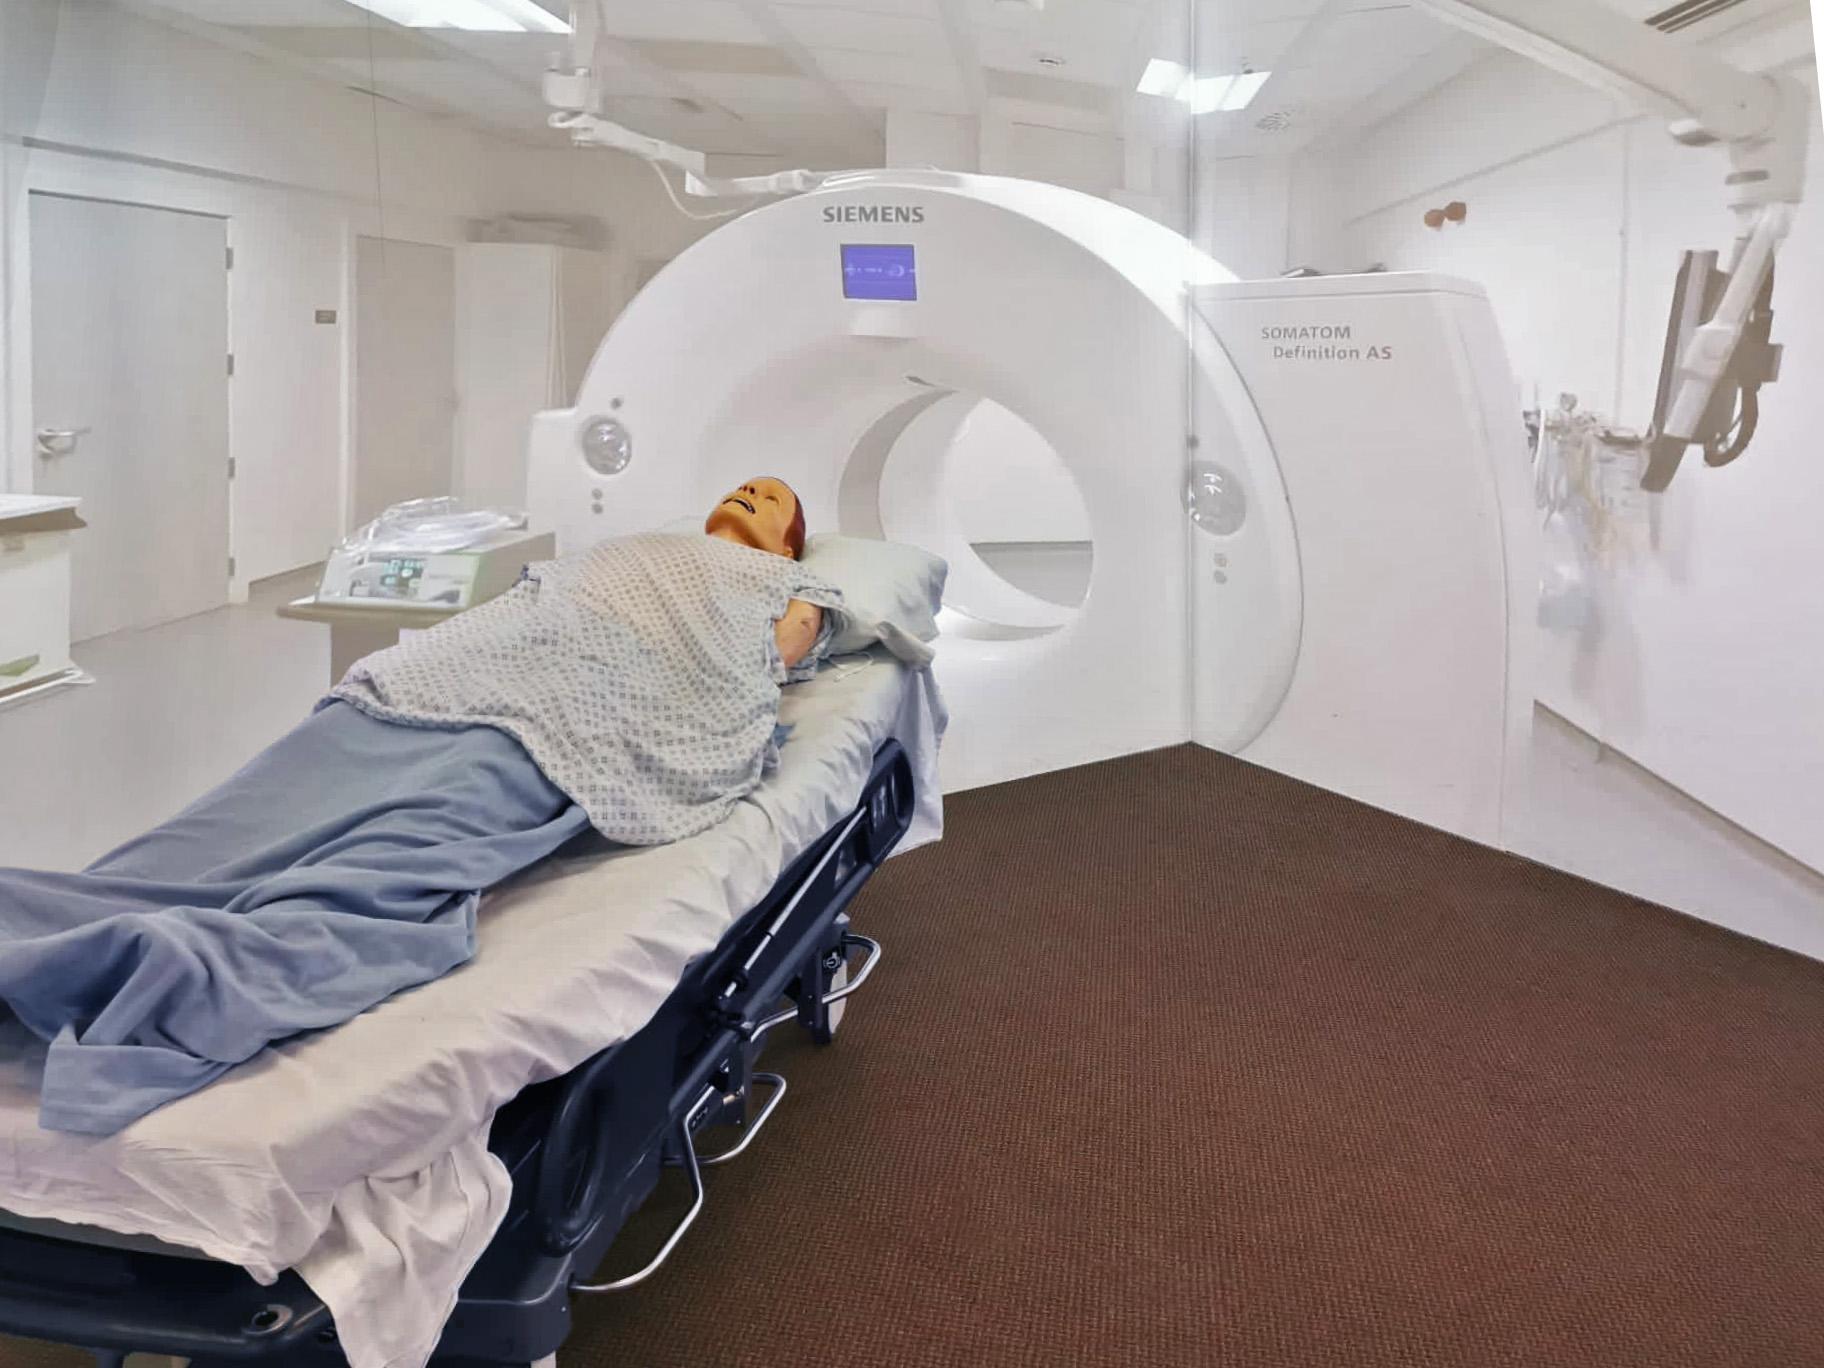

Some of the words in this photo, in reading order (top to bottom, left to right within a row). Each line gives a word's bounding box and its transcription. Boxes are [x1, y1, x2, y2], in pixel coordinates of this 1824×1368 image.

[823, 206, 925, 223] SIEMENS
[1261, 325, 1351, 339] SOMATOM
[1273, 344, 1360, 360] Definition
[1366, 345, 1392, 360] AS
